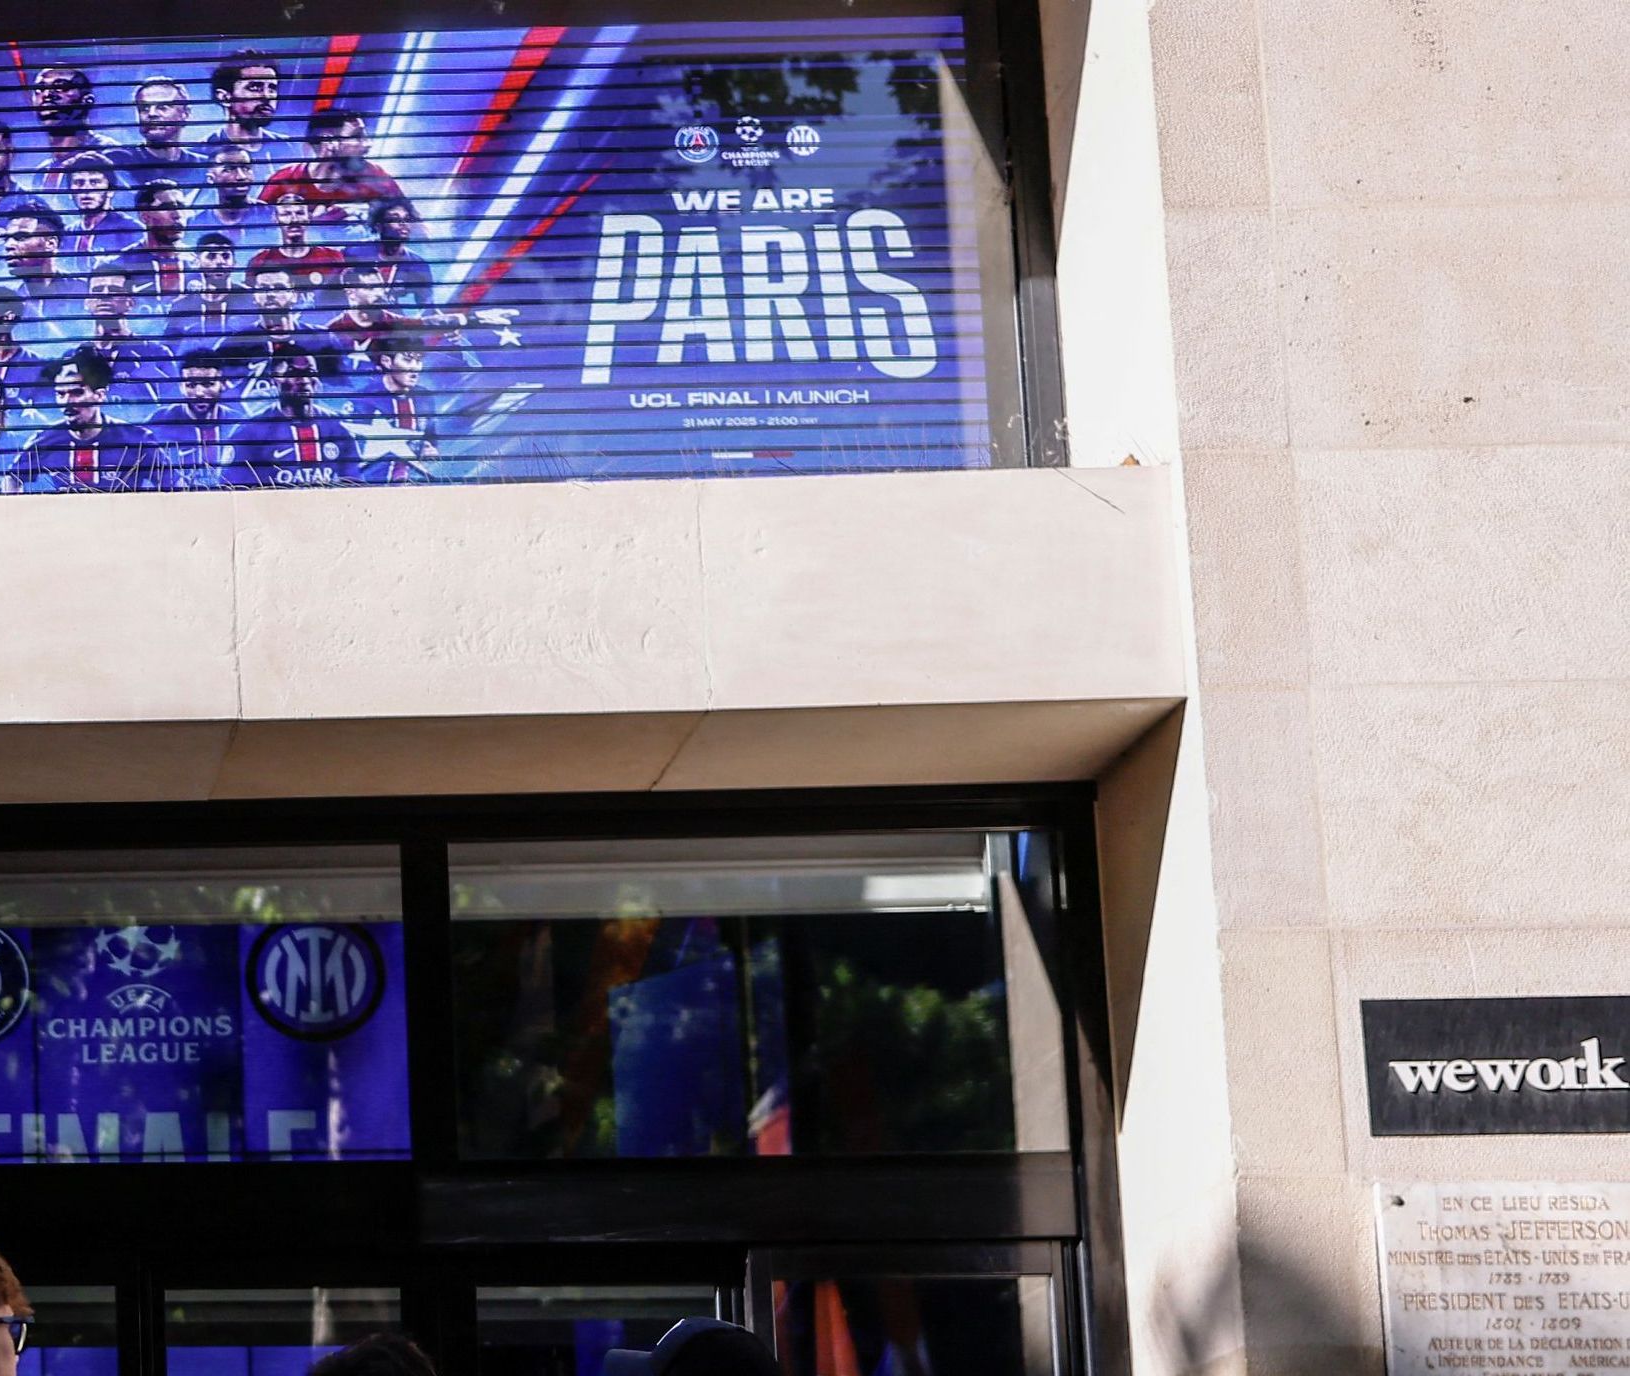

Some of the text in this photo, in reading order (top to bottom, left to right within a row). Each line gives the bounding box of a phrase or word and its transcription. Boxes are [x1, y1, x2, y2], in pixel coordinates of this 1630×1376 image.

[672, 187, 836, 214] WE ARE
[581, 207, 938, 384] PARIS
[629, 393, 681, 408] UCL
[688, 391, 759, 406] FINAL
[777, 389, 870, 405] MUNICH
[697, 417, 722, 427] MAY
[111, 988, 167, 1009] UEFA
[47, 1015, 233, 1039] CHAMPIONS
[82, 1042, 201, 1064] LEAGUE
[1388, 1036, 1630, 1092] wework
[1443, 1196, 1463, 1211] EN
[1471, 1196, 1492, 1211] CE
[1503, 1196, 1541, 1211] LIEU
[1418, 1219, 1629, 1241] THOMAS JEFFERSON
[1388, 1250, 1454, 1265] MINISTRE
[1513, 1295, 1545, 1311] DES
[1428, 1337, 1483, 1351] AUTEUR
[1488, 1337, 1503, 1350] DE
[1508, 1337, 1525, 1350] LA
